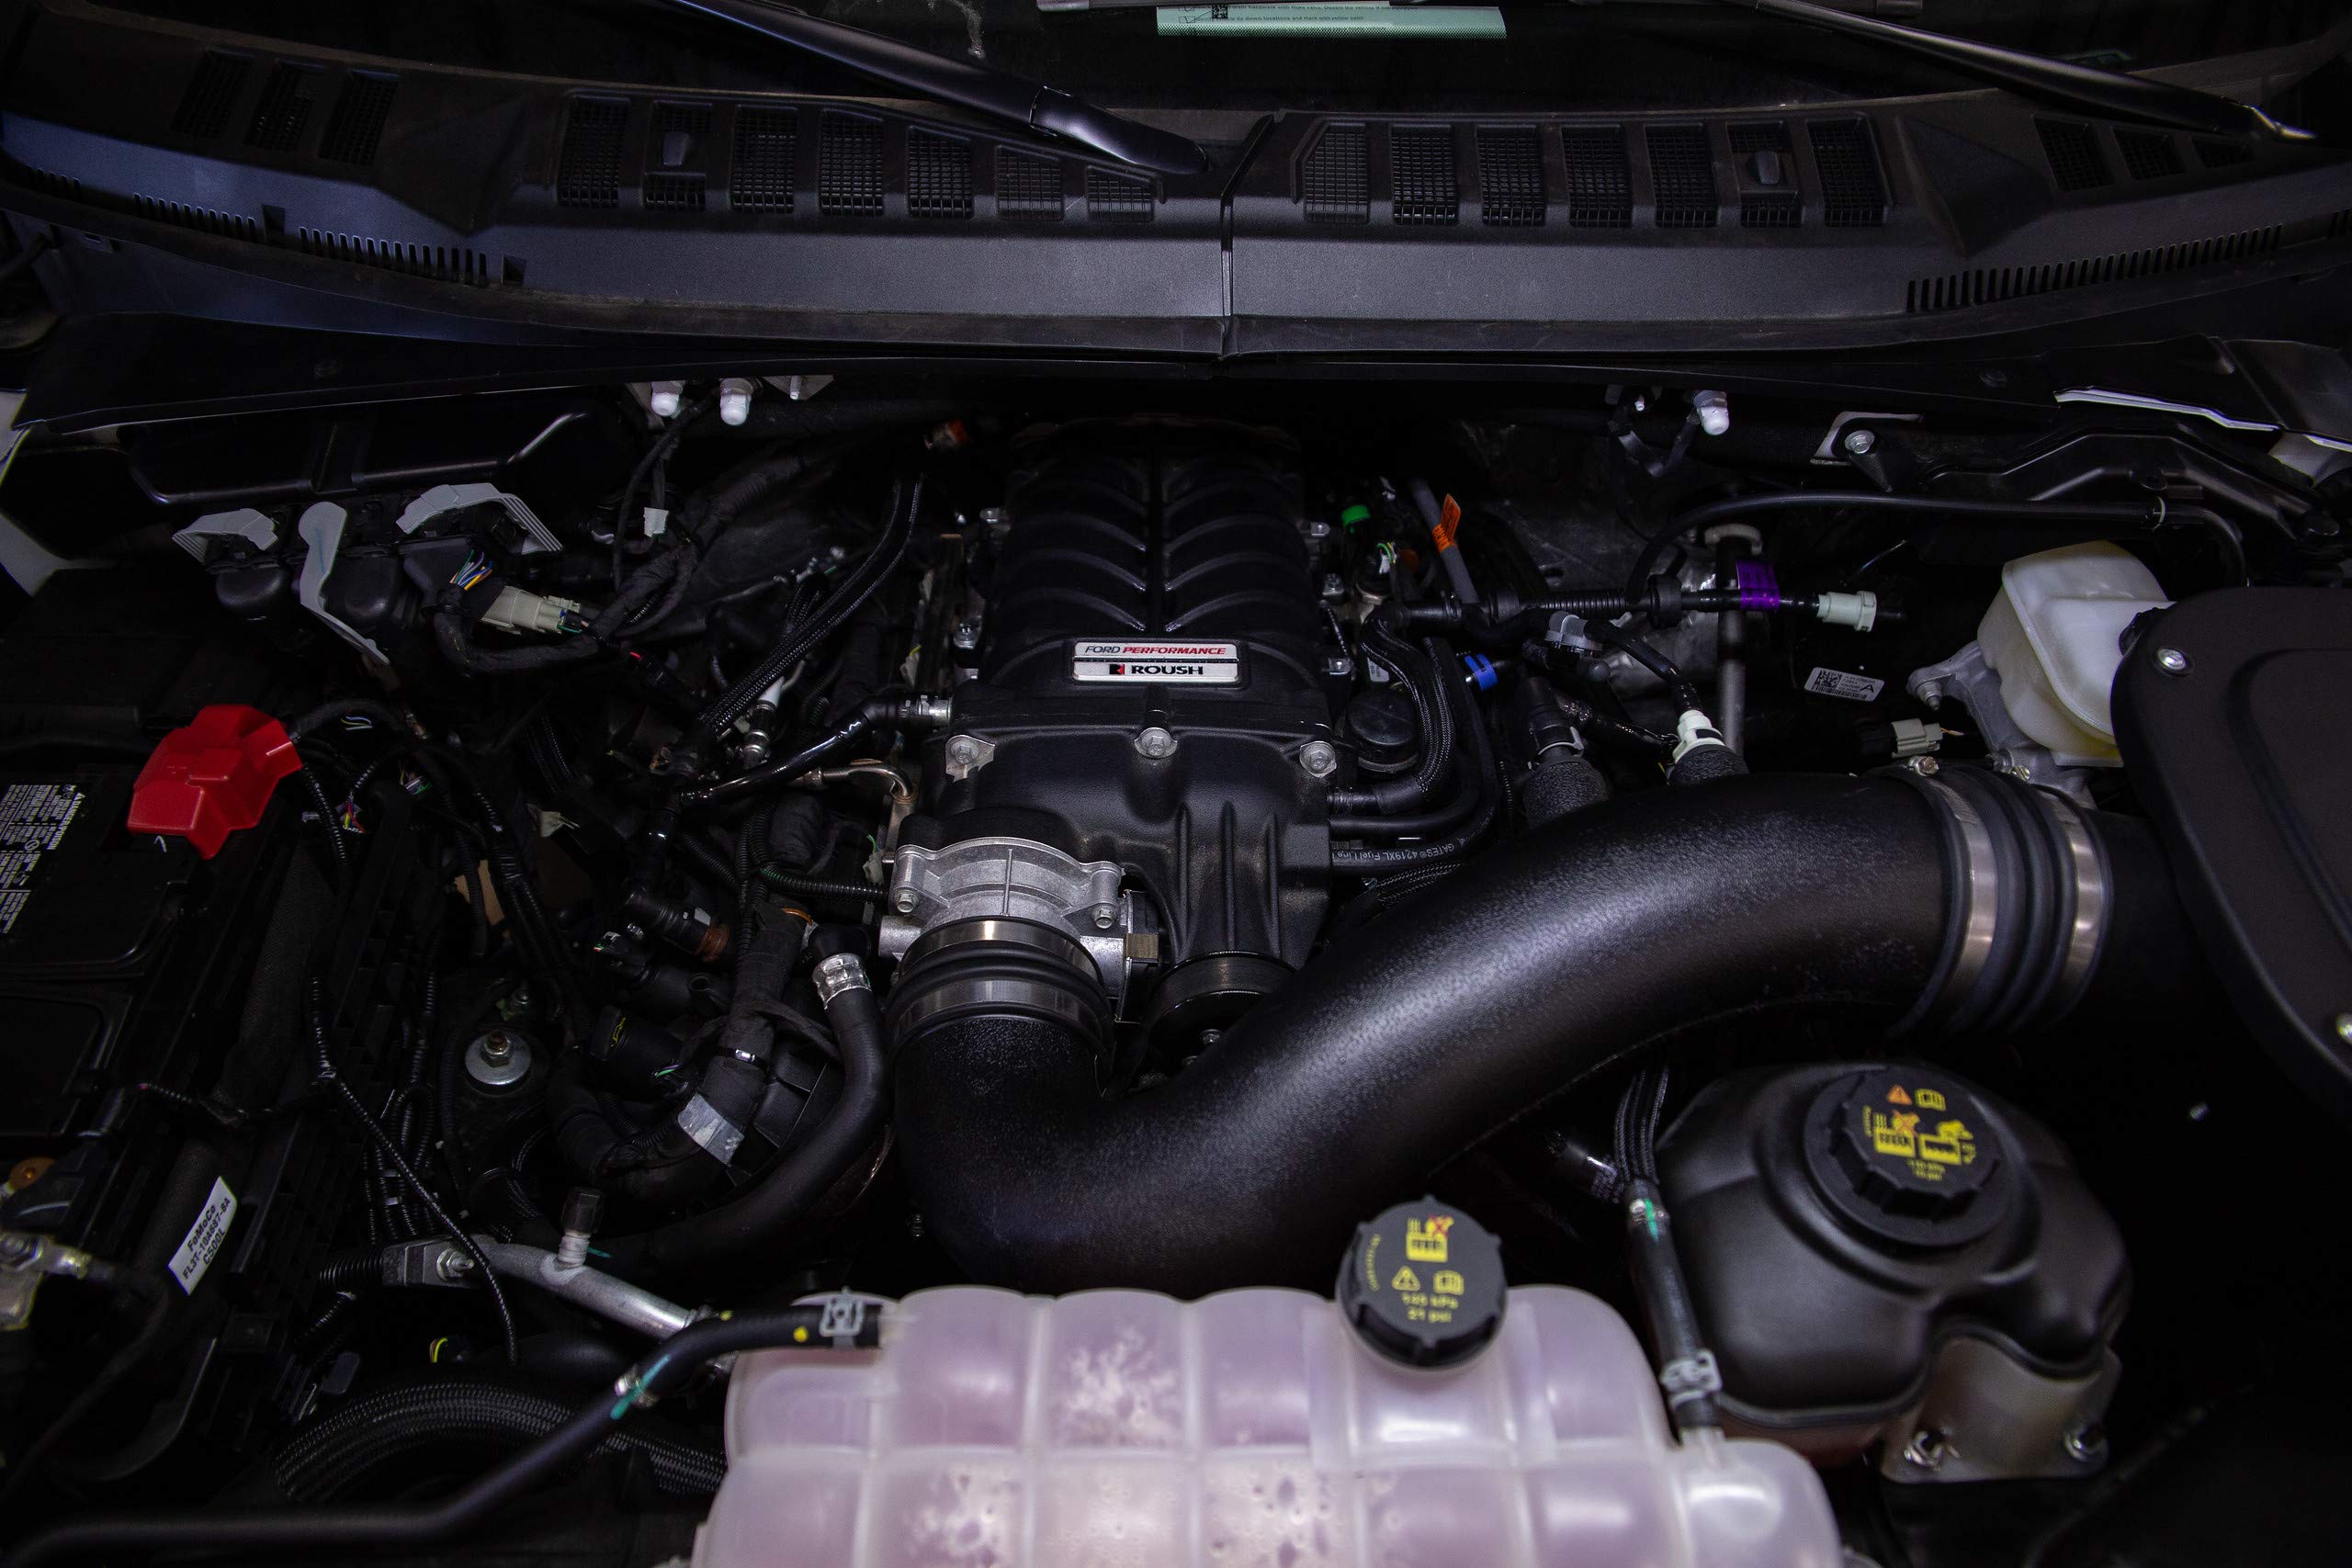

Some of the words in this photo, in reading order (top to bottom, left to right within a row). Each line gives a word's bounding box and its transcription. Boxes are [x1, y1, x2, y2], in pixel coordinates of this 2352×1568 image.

[1085, 645, 1121, 654] FORD
[1122, 646, 1227, 655] PERFORMANCE
[1131, 664, 1204, 675] ROUSH
[187, 1204, 217, 1252] FoMoCo
